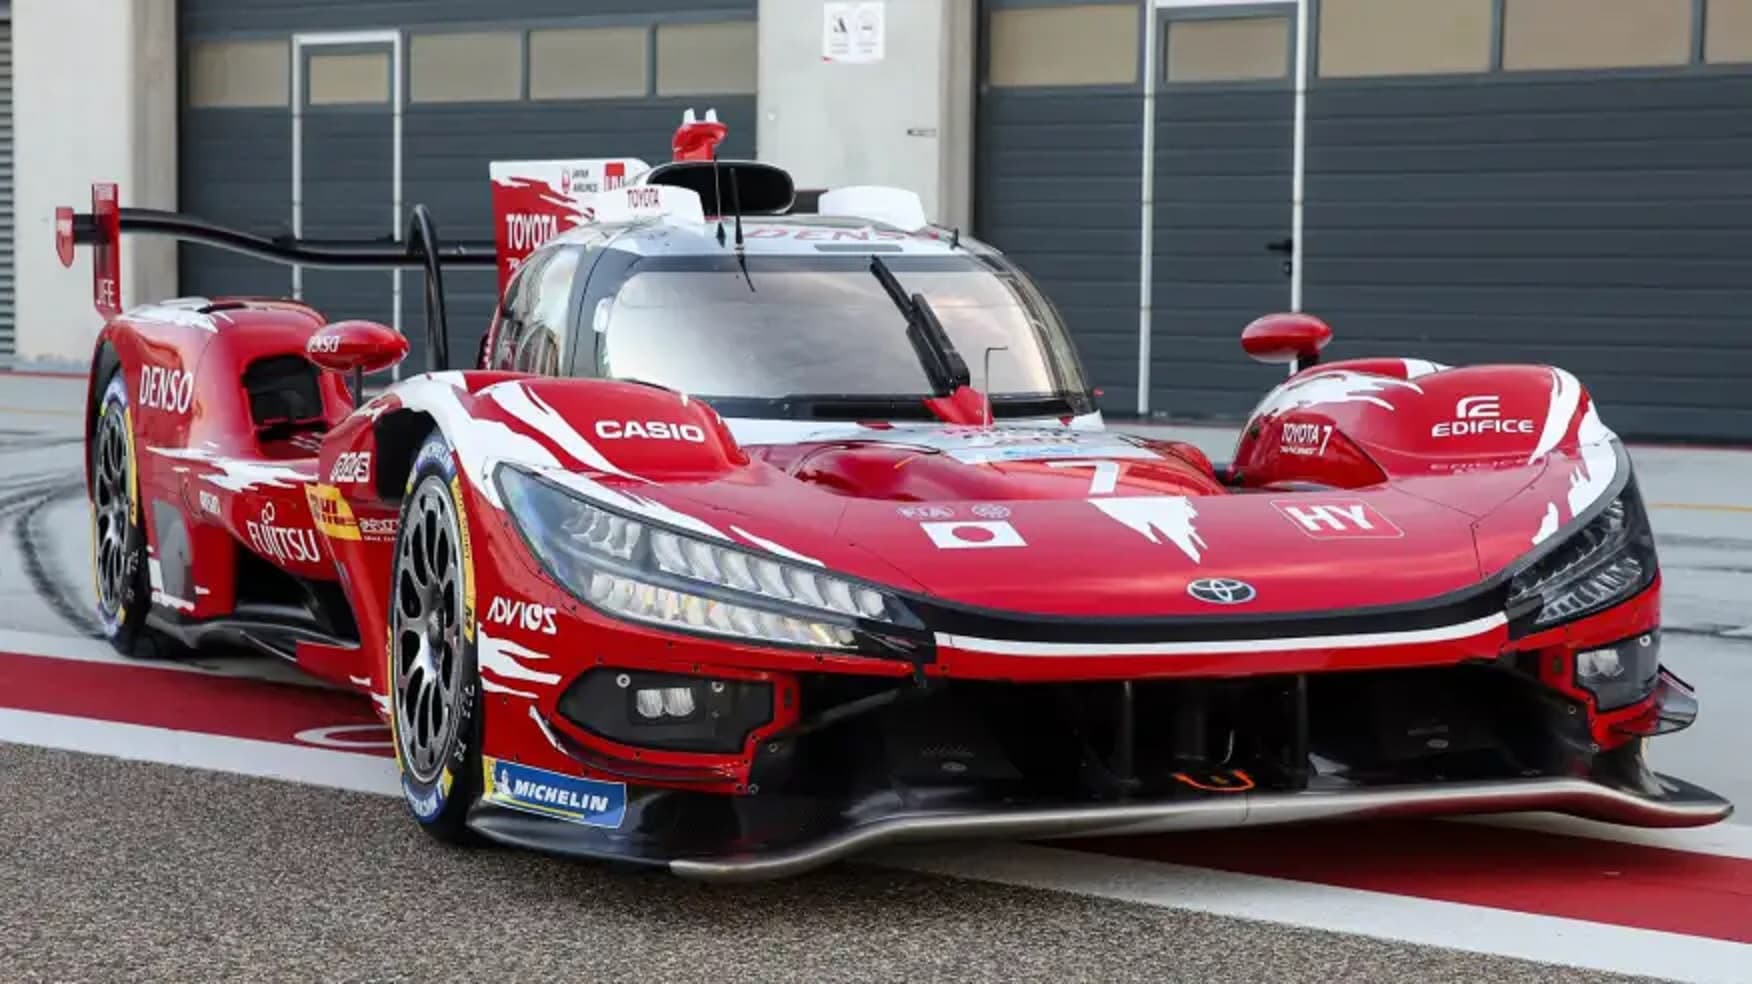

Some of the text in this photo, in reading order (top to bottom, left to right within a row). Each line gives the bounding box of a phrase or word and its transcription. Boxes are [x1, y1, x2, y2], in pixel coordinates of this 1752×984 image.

[627, 188, 660, 208] TOYOTA
[139, 364, 194, 415] DENSO
[595, 420, 705, 443] CASIO
[1281, 423, 1333, 457] TOYOTA 7
[1431, 419, 1535, 438] EDIFICE
[1284, 504, 1376, 532] HY
[246, 519, 321, 566] FUJITSU
[513, 778, 609, 812] MICHELIN
